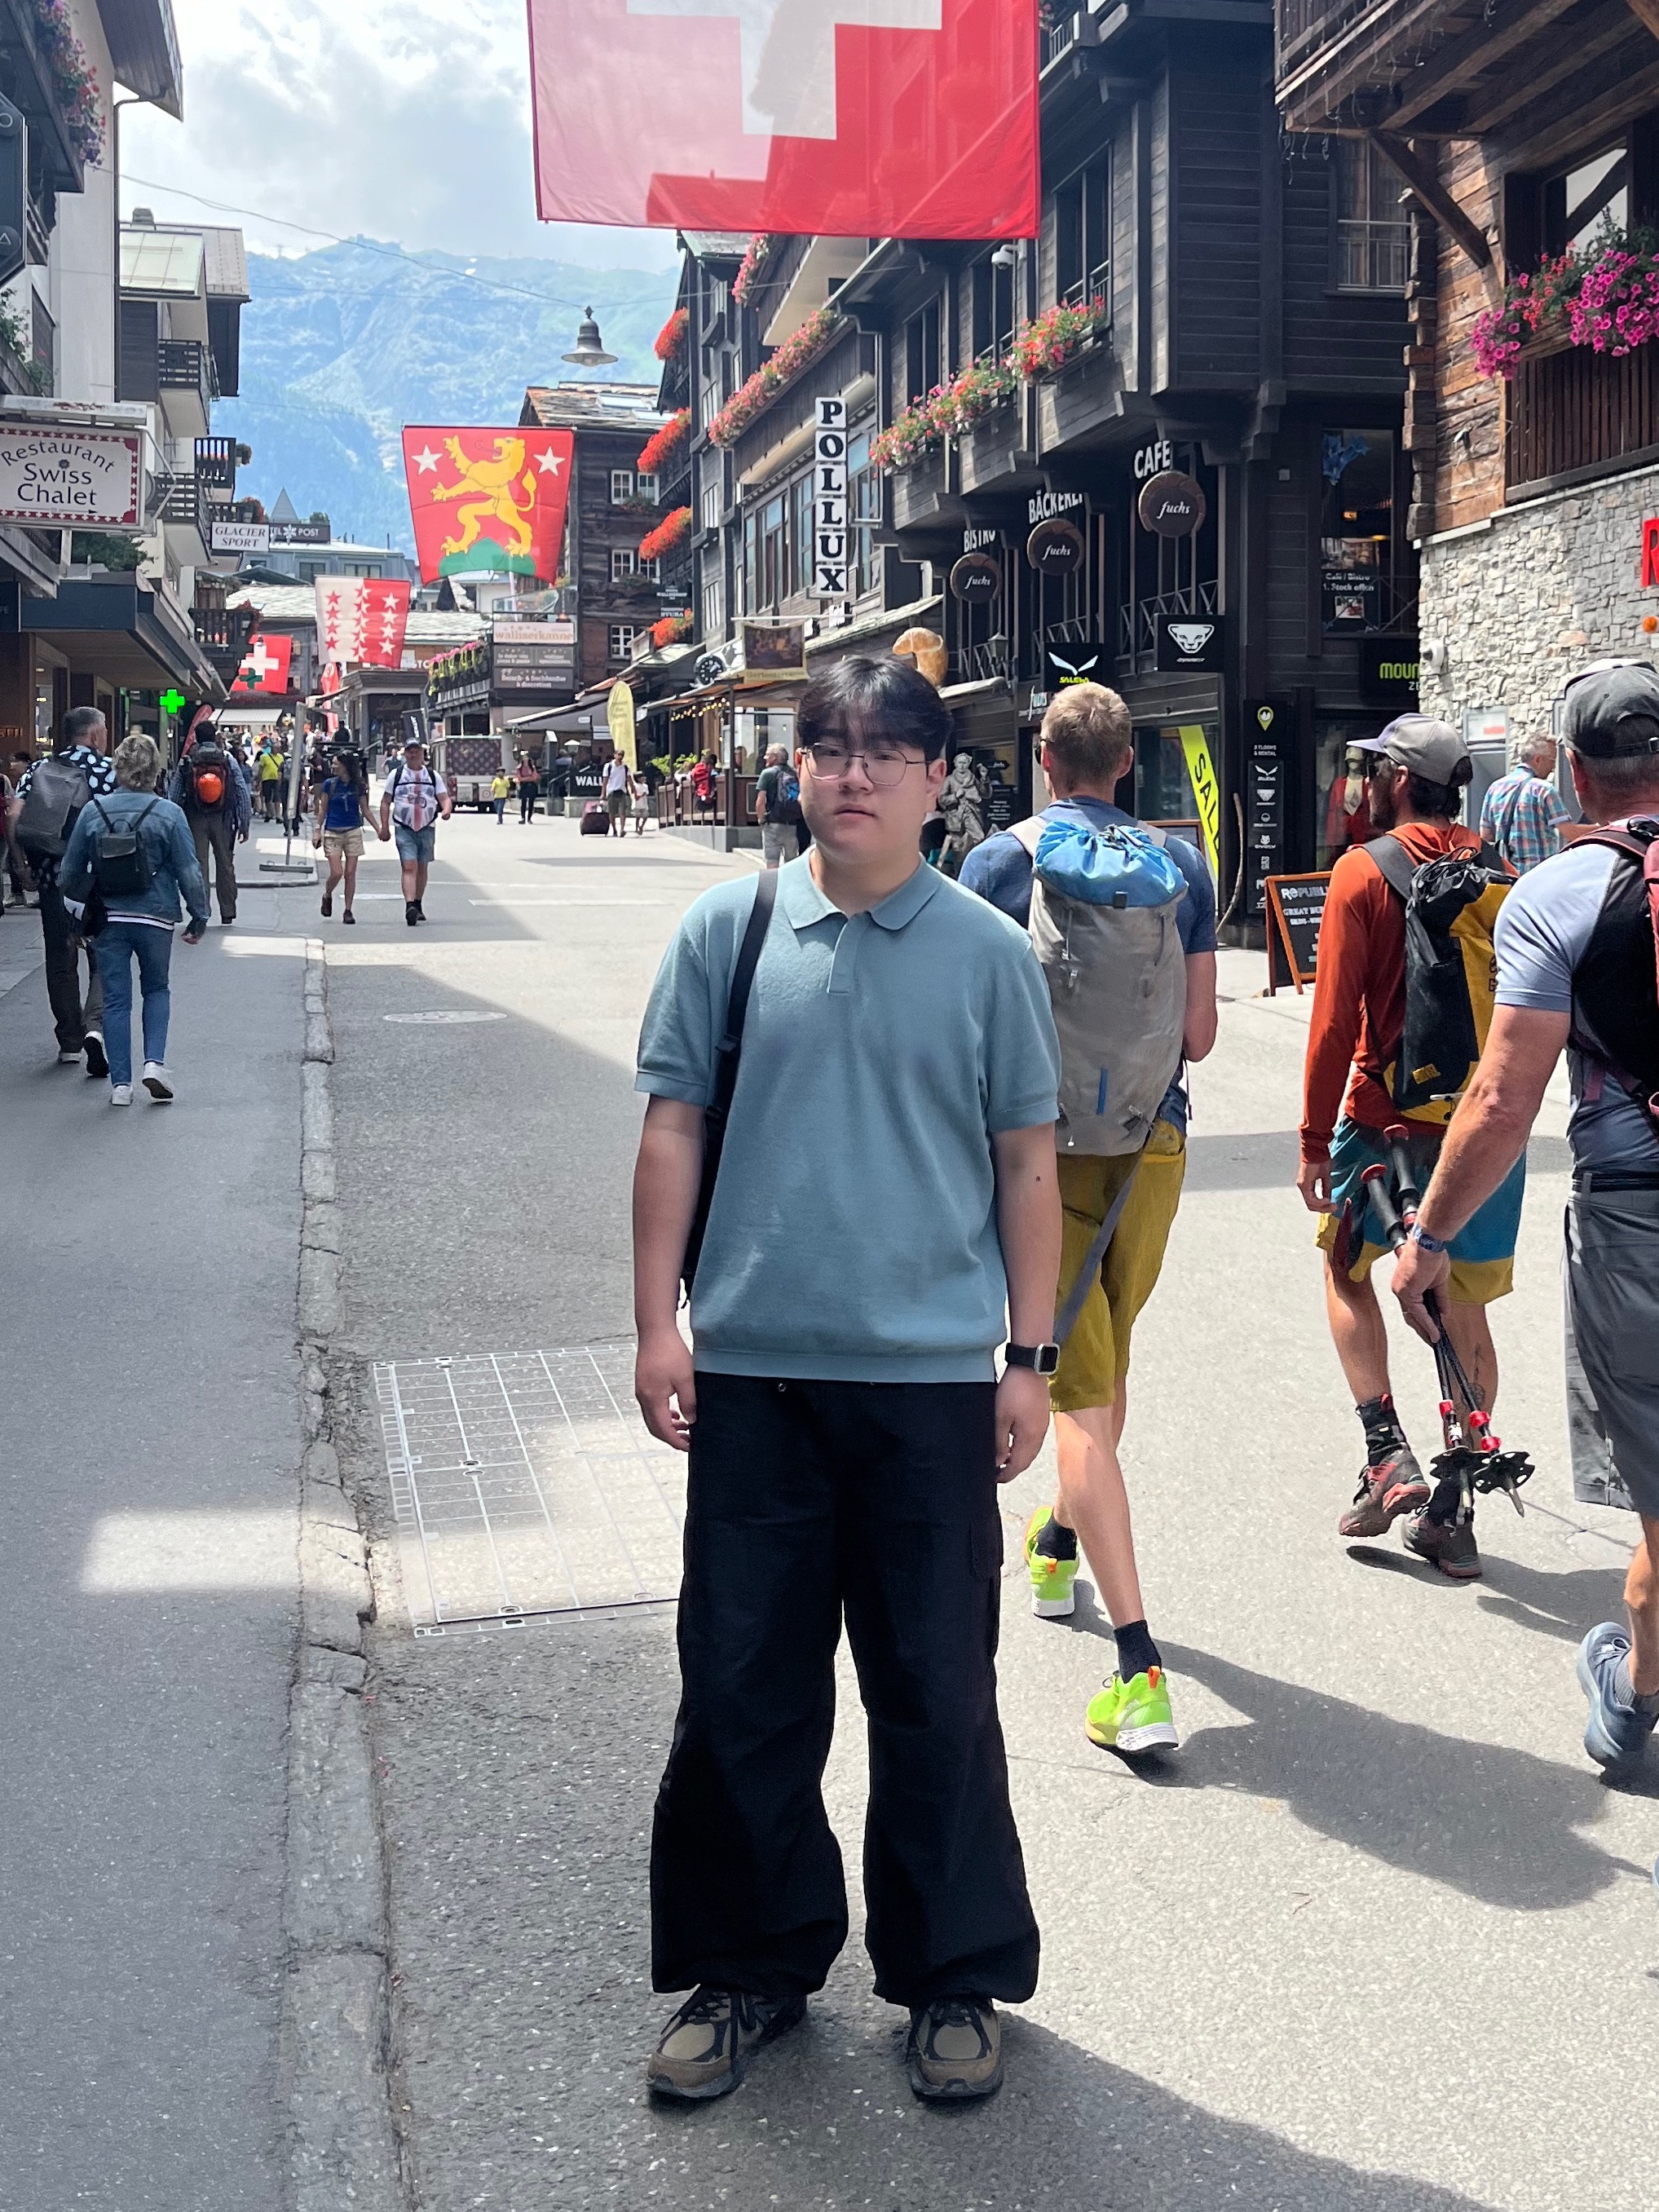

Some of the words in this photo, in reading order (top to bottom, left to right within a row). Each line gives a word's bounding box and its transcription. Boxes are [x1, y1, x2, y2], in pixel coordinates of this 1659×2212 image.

[1, 439, 115, 473] Restaurant
[24, 462, 92, 485] Swiss
[17, 483, 97, 506] Chalet
[818, 400, 845, 592] POLLUX
[1156, 501, 1190, 519] fuchs
[215, 526, 266, 537] GLACIER
[298, 528, 320, 538] POST
[222, 537, 260, 547] SPORT
[1041, 544, 1071, 560] fuchs
[964, 575, 991, 589] fuchs
